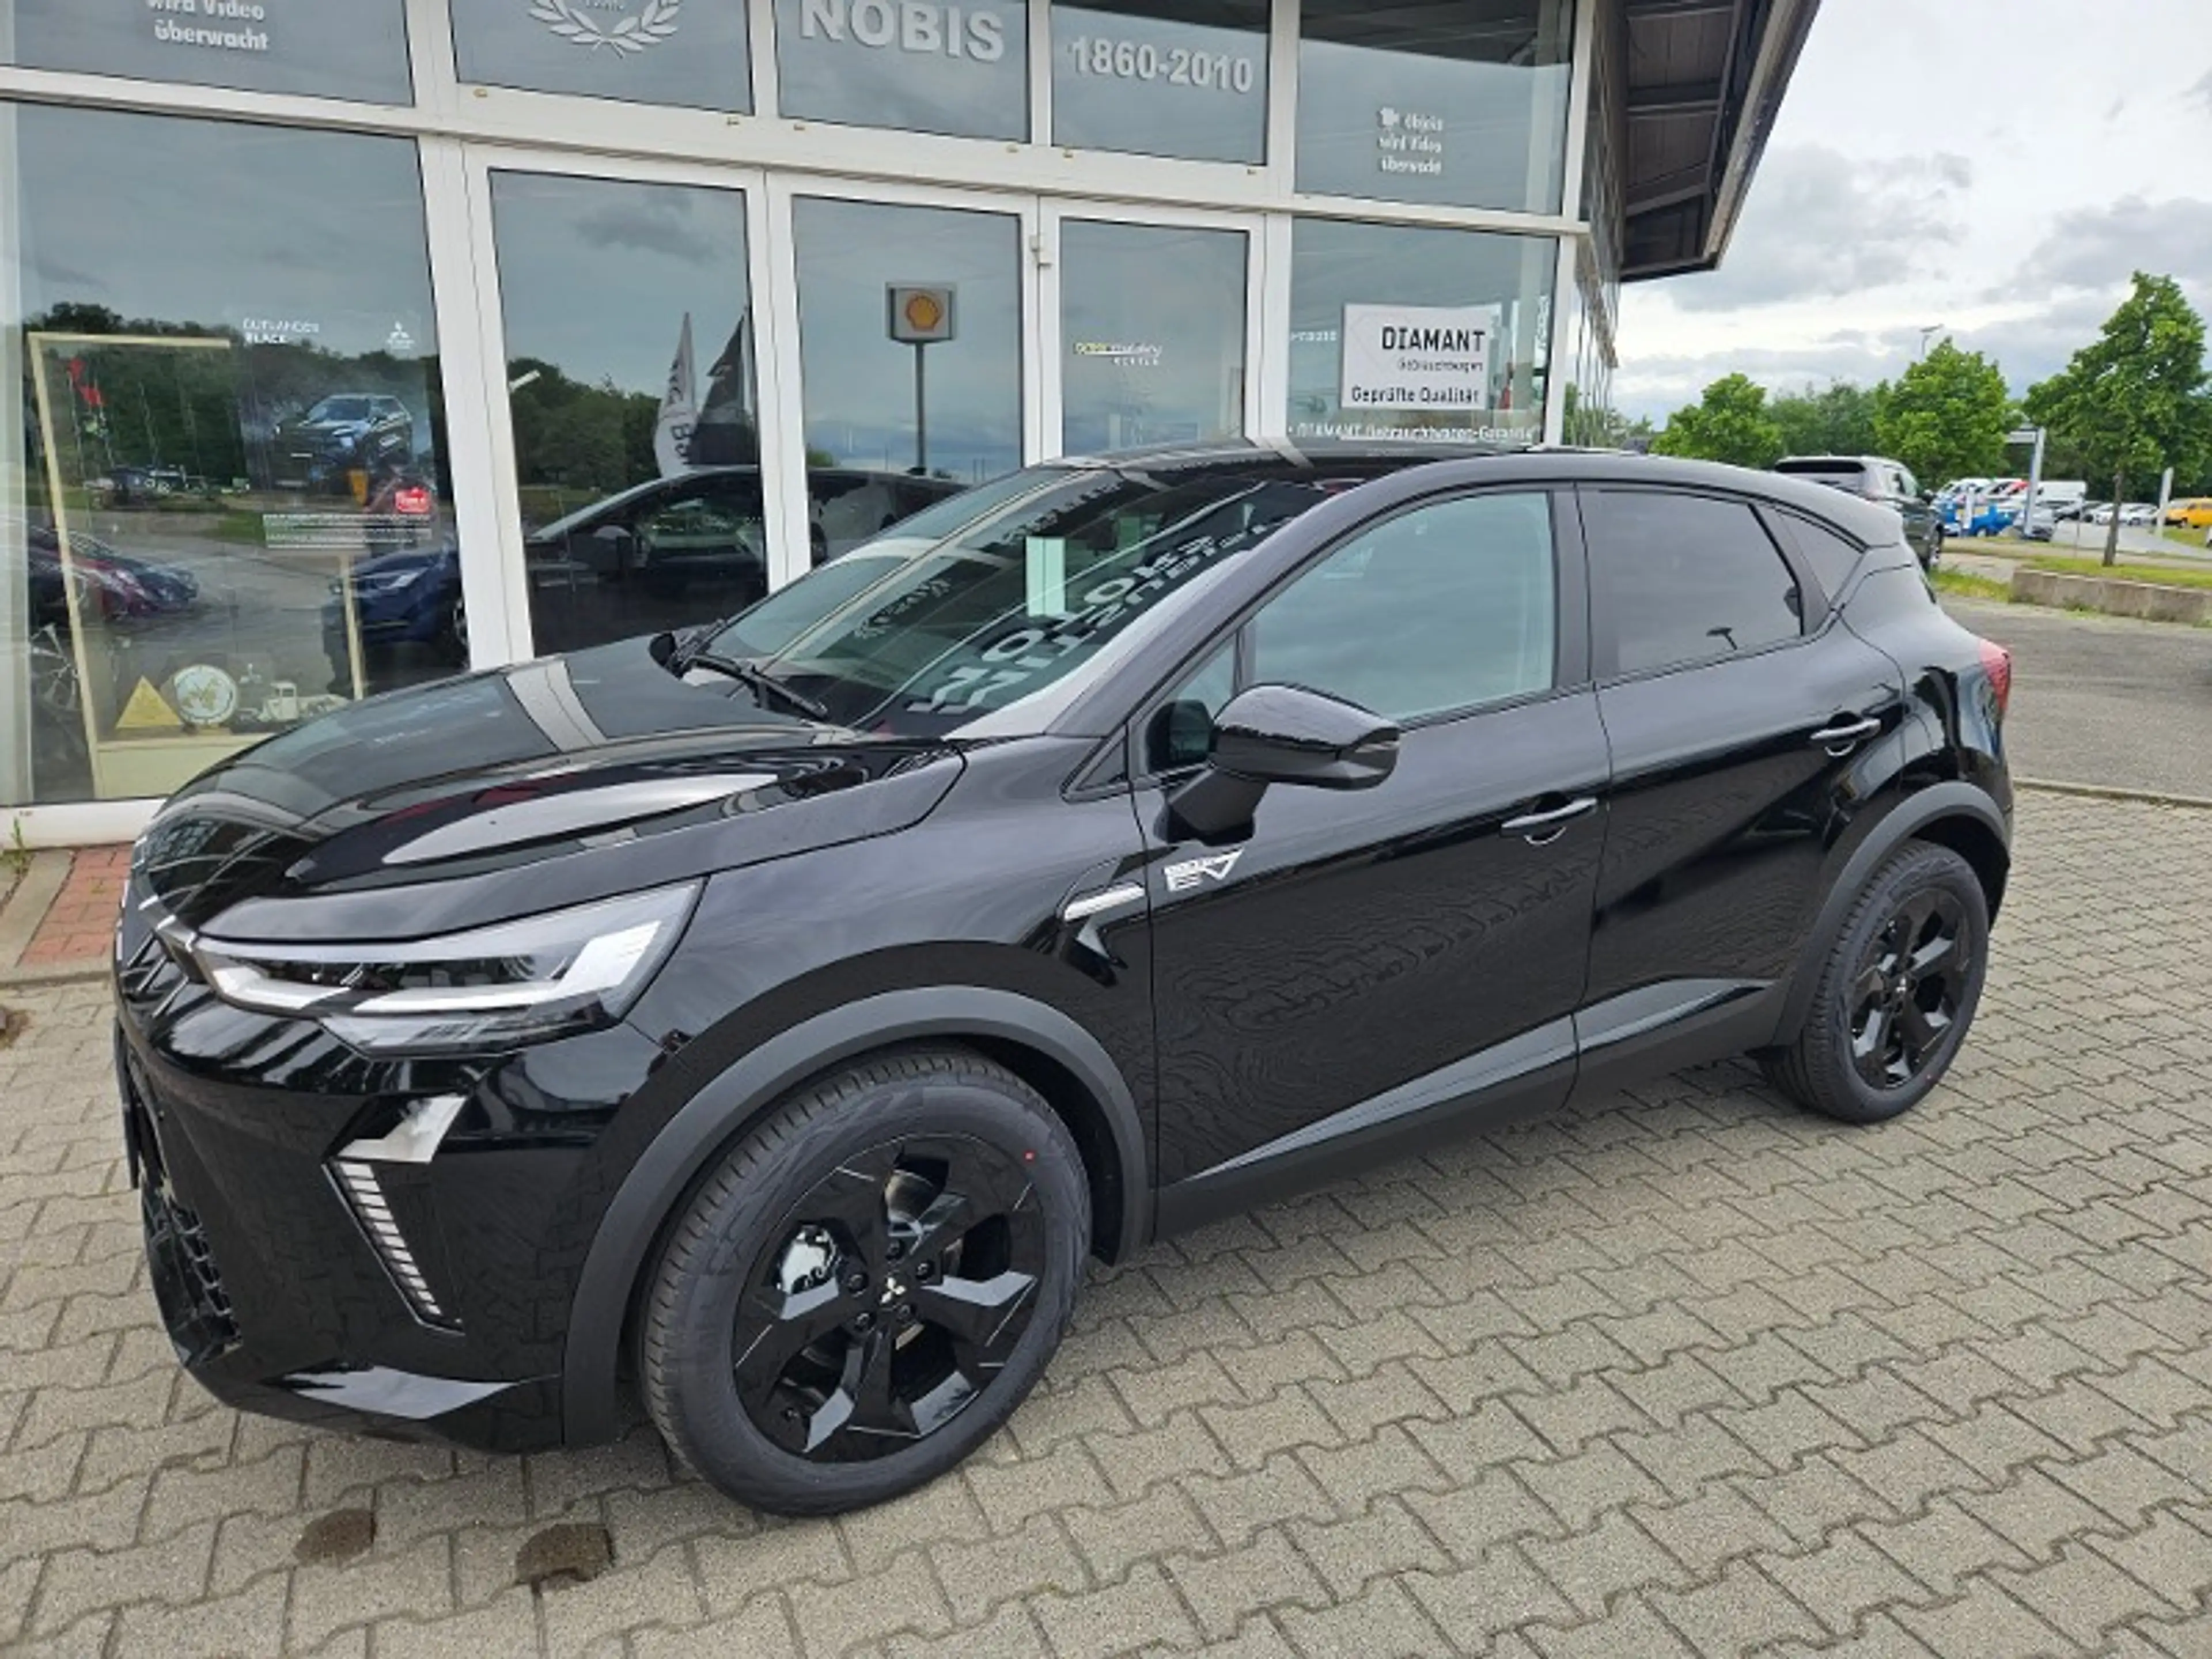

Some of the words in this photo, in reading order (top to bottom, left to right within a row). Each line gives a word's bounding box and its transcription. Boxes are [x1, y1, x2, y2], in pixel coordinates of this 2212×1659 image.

[154, 19, 268, 51] überwacht
[800, 0, 1005, 63] NOBIS
[1068, 36, 1253, 93] 1860-2010
[1382, 325, 1485, 352] DIAMANT
[1351, 384, 1415, 404] Geprüfte
[1419, 385, 1479, 404] Qualität
